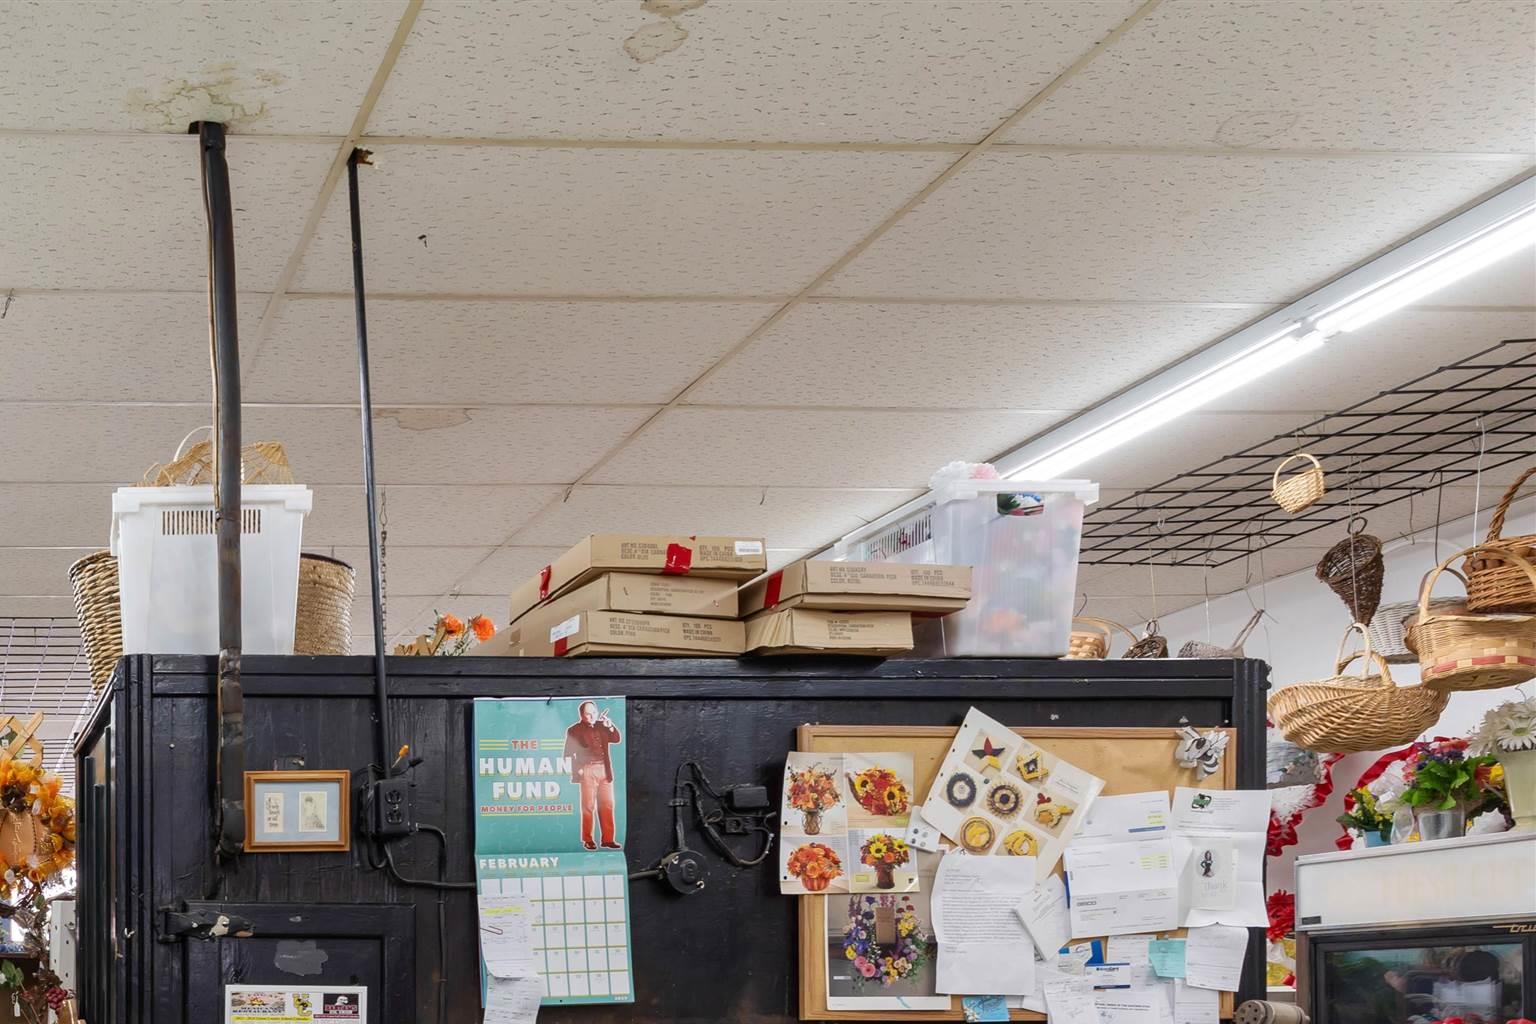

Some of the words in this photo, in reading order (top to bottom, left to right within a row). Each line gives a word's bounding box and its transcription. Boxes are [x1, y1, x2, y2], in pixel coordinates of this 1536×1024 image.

[511, 740, 538, 750] THE
[479, 756, 573, 777] HUMAN
[492, 781, 561, 800] FUND
[537, 804, 573, 812] PEOPLE
[479, 856, 560, 870] FEBRUARY
